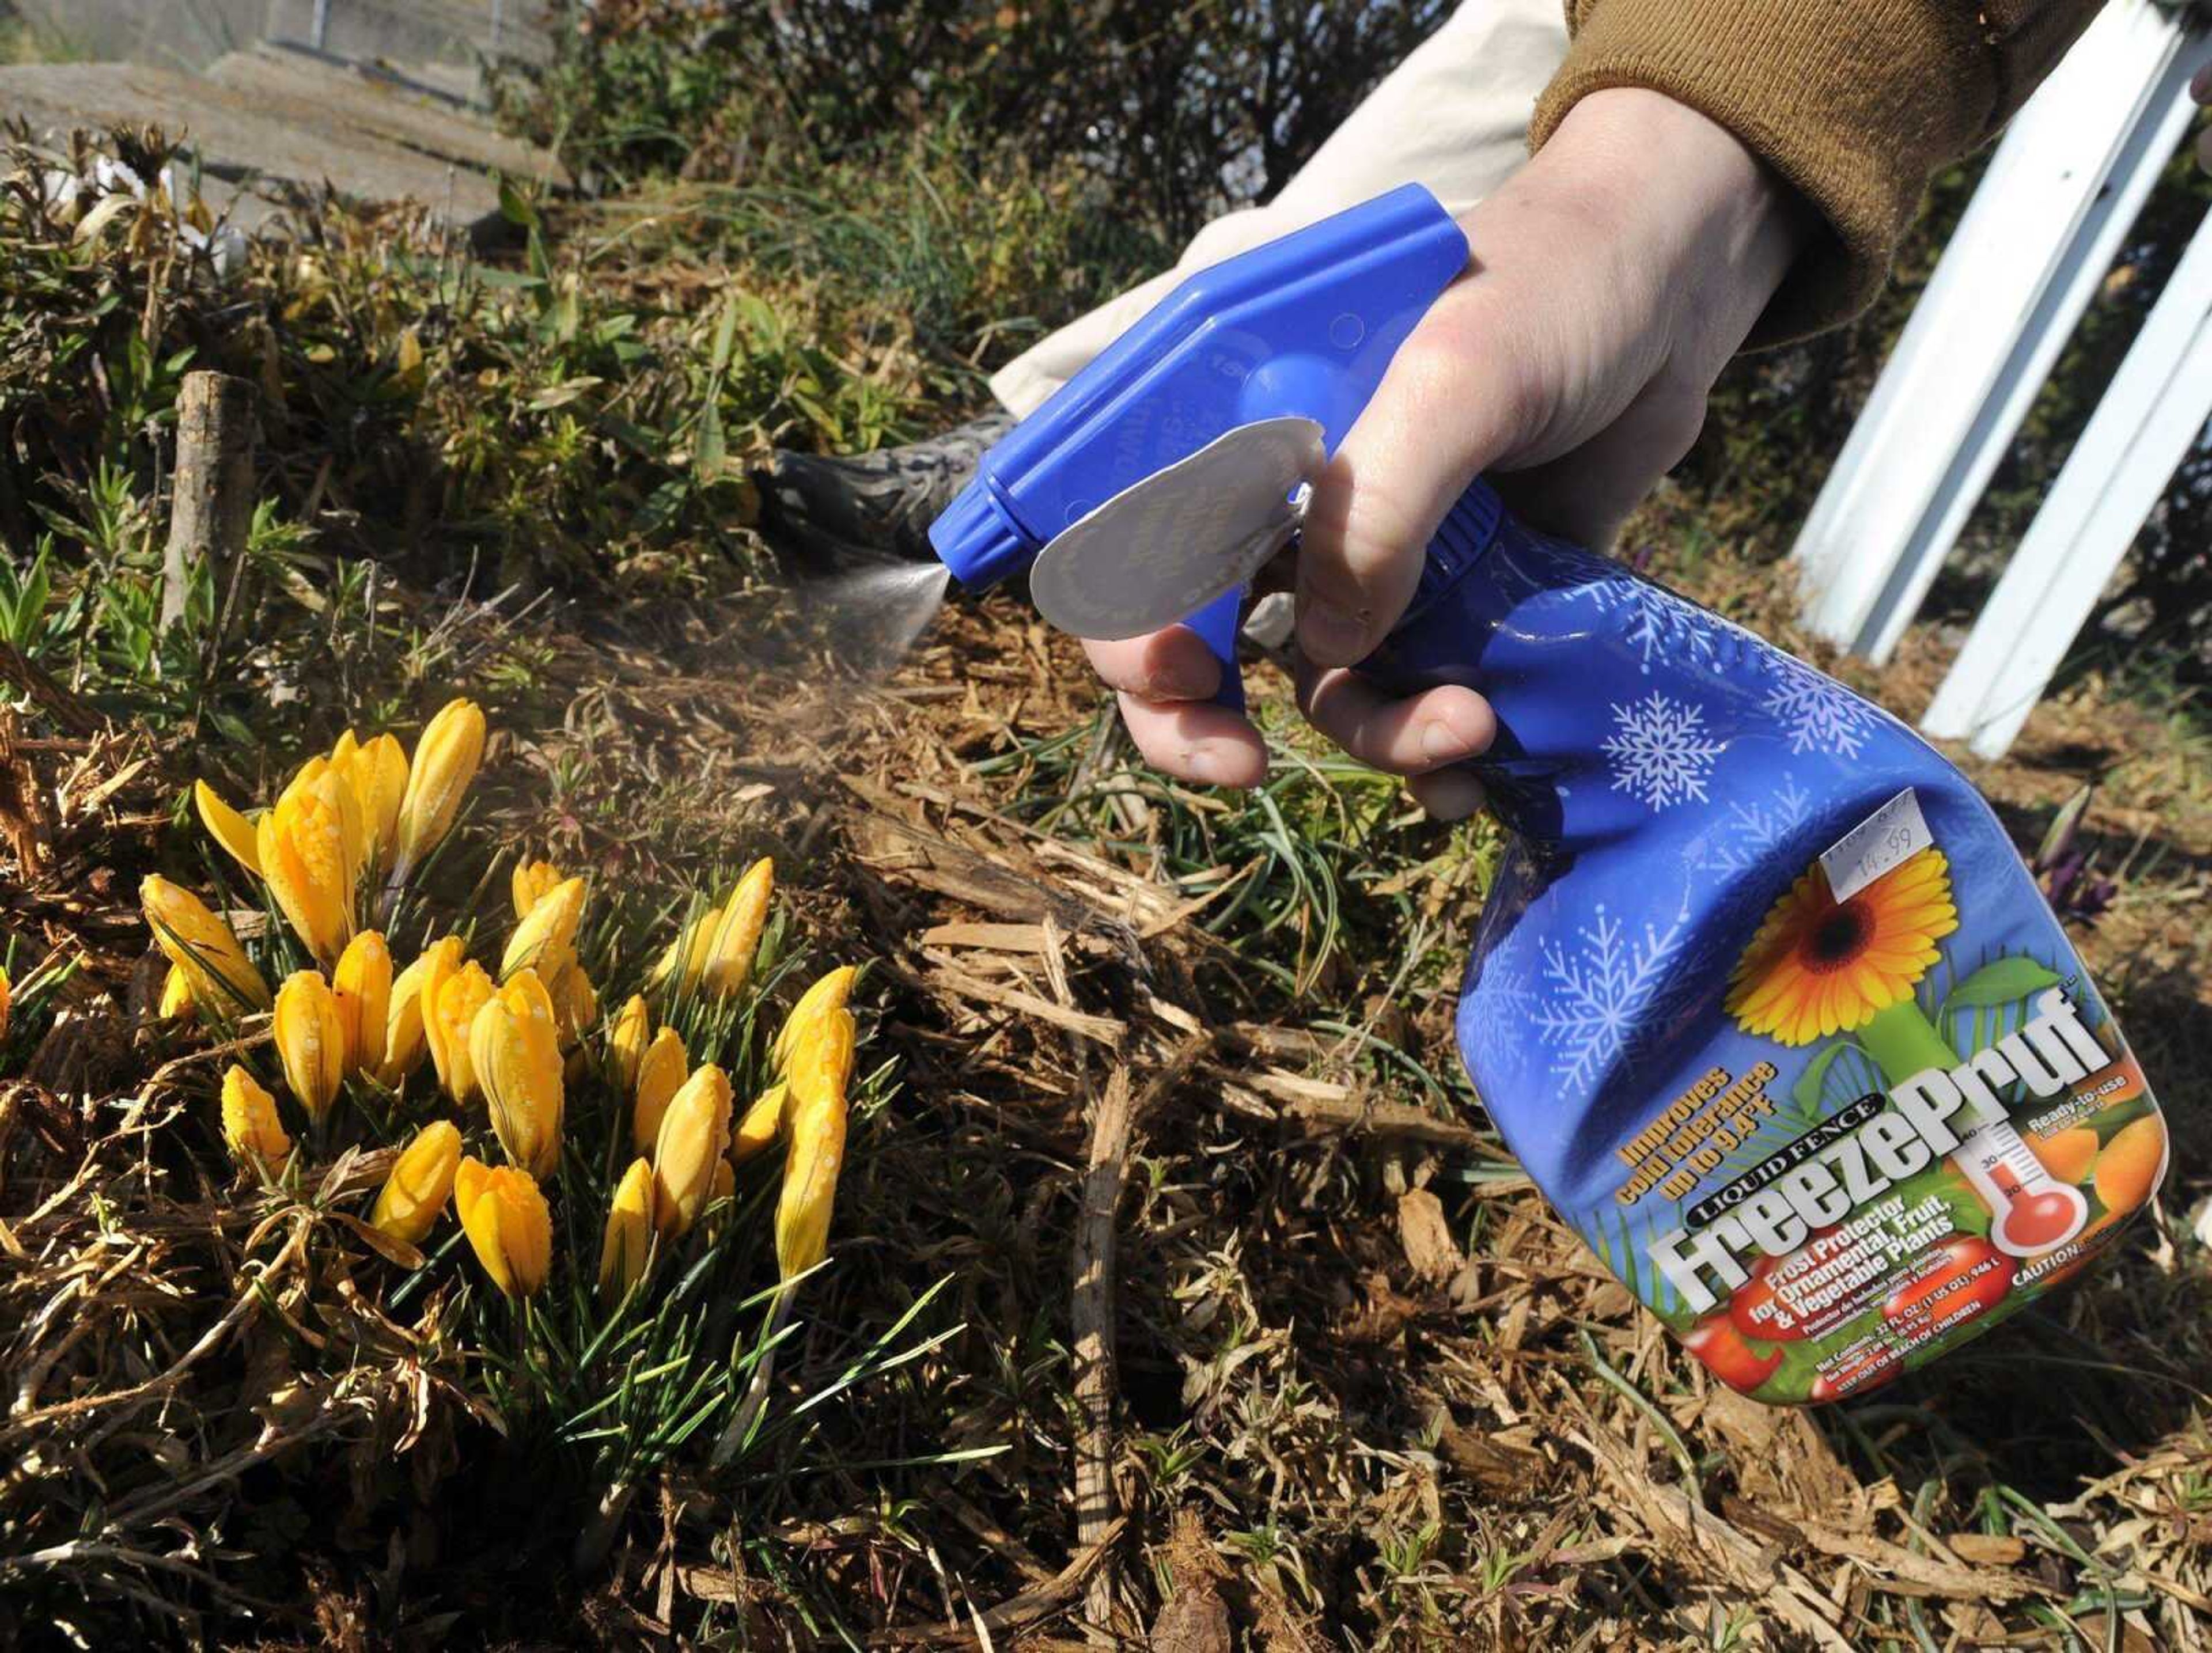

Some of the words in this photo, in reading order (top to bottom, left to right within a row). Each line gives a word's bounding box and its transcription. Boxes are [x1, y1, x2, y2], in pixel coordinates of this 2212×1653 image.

[1615, 1068, 1732, 1169] Improves
[1615, 1154, 1672, 1206] cold
[1665, 1061, 1779, 1162] tolerance
[1647, 988, 2111, 1314] FreezePruf
[2027, 1076, 2127, 1133] Ready-to-use
[1658, 1169, 1699, 1201] up
[1687, 1148, 1724, 1174] to
[1698, 1157, 1786, 1220] LIQUID
[1788, 1102, 1877, 1159] FENCE
[1748, 1298, 1781, 1325] for
[1777, 1228, 1895, 1305] Ornamental,
[1894, 1193, 1953, 1234] Fruit,
[1764, 1252, 1815, 1290] Frost
[1812, 1194, 1906, 1261] Protector
[1774, 1309, 1796, 1330] &
[1793, 1254, 1889, 1319] Vegetable
[1887, 1213, 1955, 1262] Plants
[1857, 1364, 1876, 1379] OUT
[1888, 1336, 1921, 1360] REACH
[1919, 1328, 1932, 1341] OF
[1932, 1300, 1981, 1333] CHILDREN
